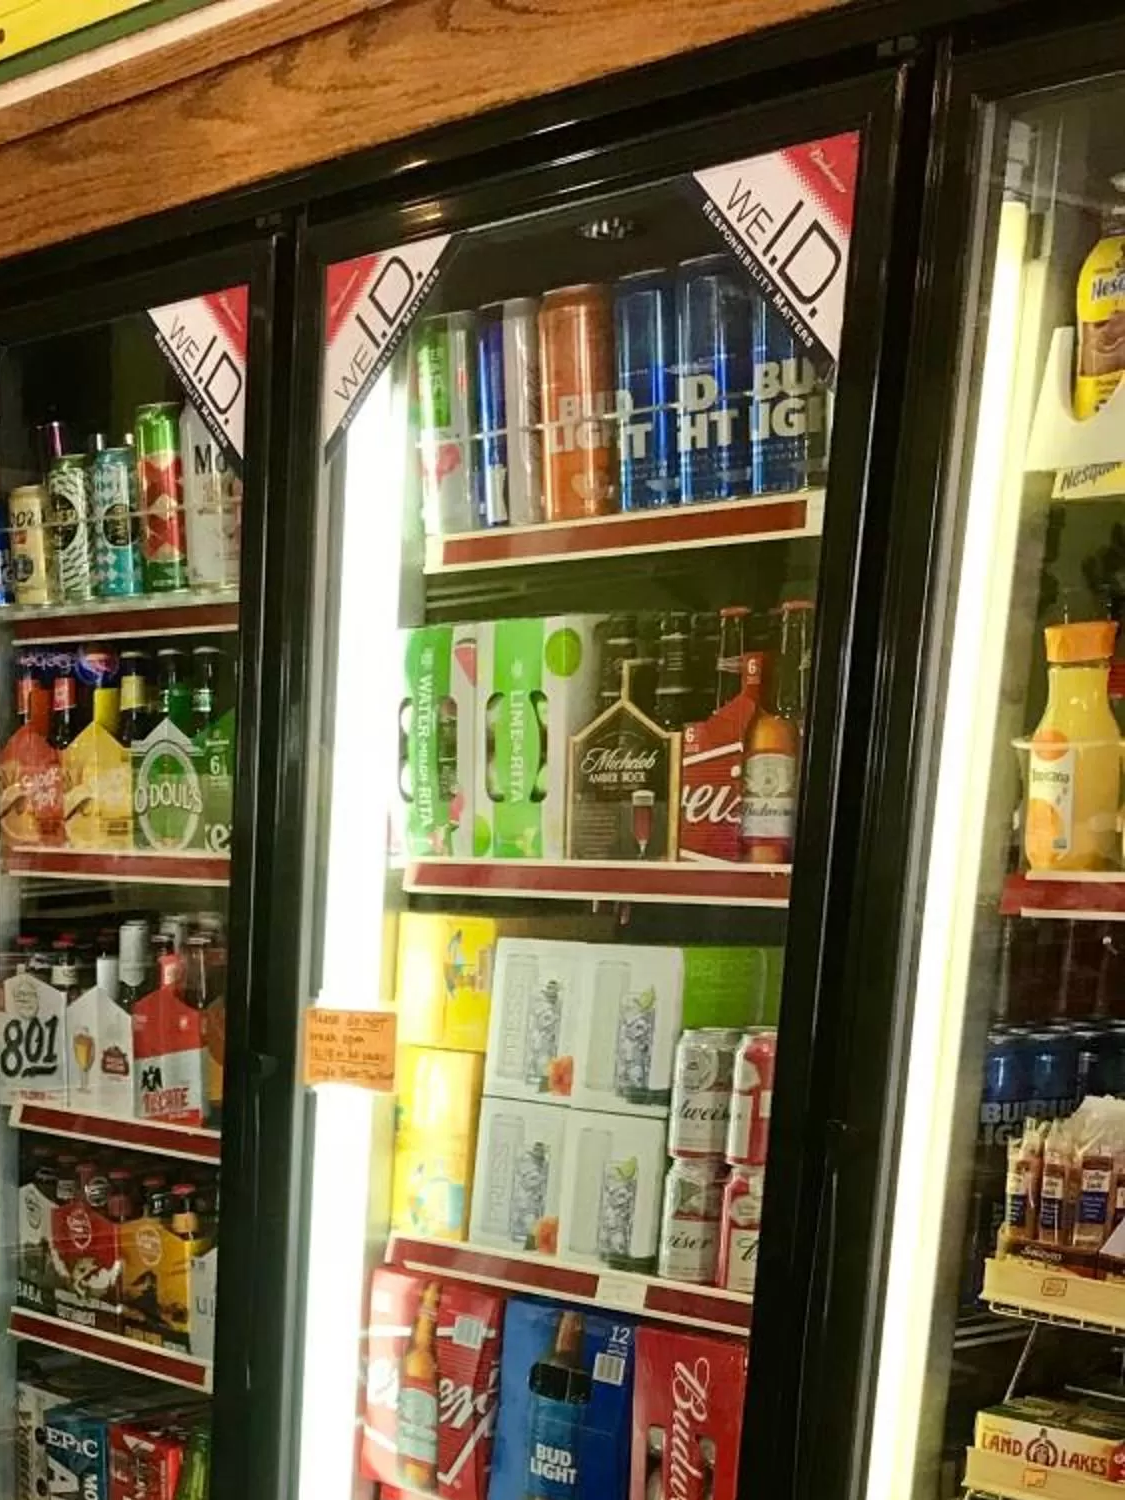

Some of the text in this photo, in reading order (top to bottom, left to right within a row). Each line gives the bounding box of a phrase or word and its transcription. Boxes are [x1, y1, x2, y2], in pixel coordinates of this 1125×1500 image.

[727, 177, 774, 246] WE
[402, 266, 441, 327] MATTERS
[170, 315, 200, 369] WE
[771, 291, 815, 349] MATTERS
[334, 344, 374, 401] WE
[747, 658, 757, 675] 6
[684, 727, 694, 743] 6
[580, 746, 659, 774] Michelob
[0, 1015, 60, 1078] 801
[609, 1325, 630, 1345] 12
[529, 1460, 578, 1486] LIGHT
[535, 1443, 573, 1468] BUD
[981, 1431, 1023, 1457] LAND
[1060, 1448, 1107, 1476] LAKES
